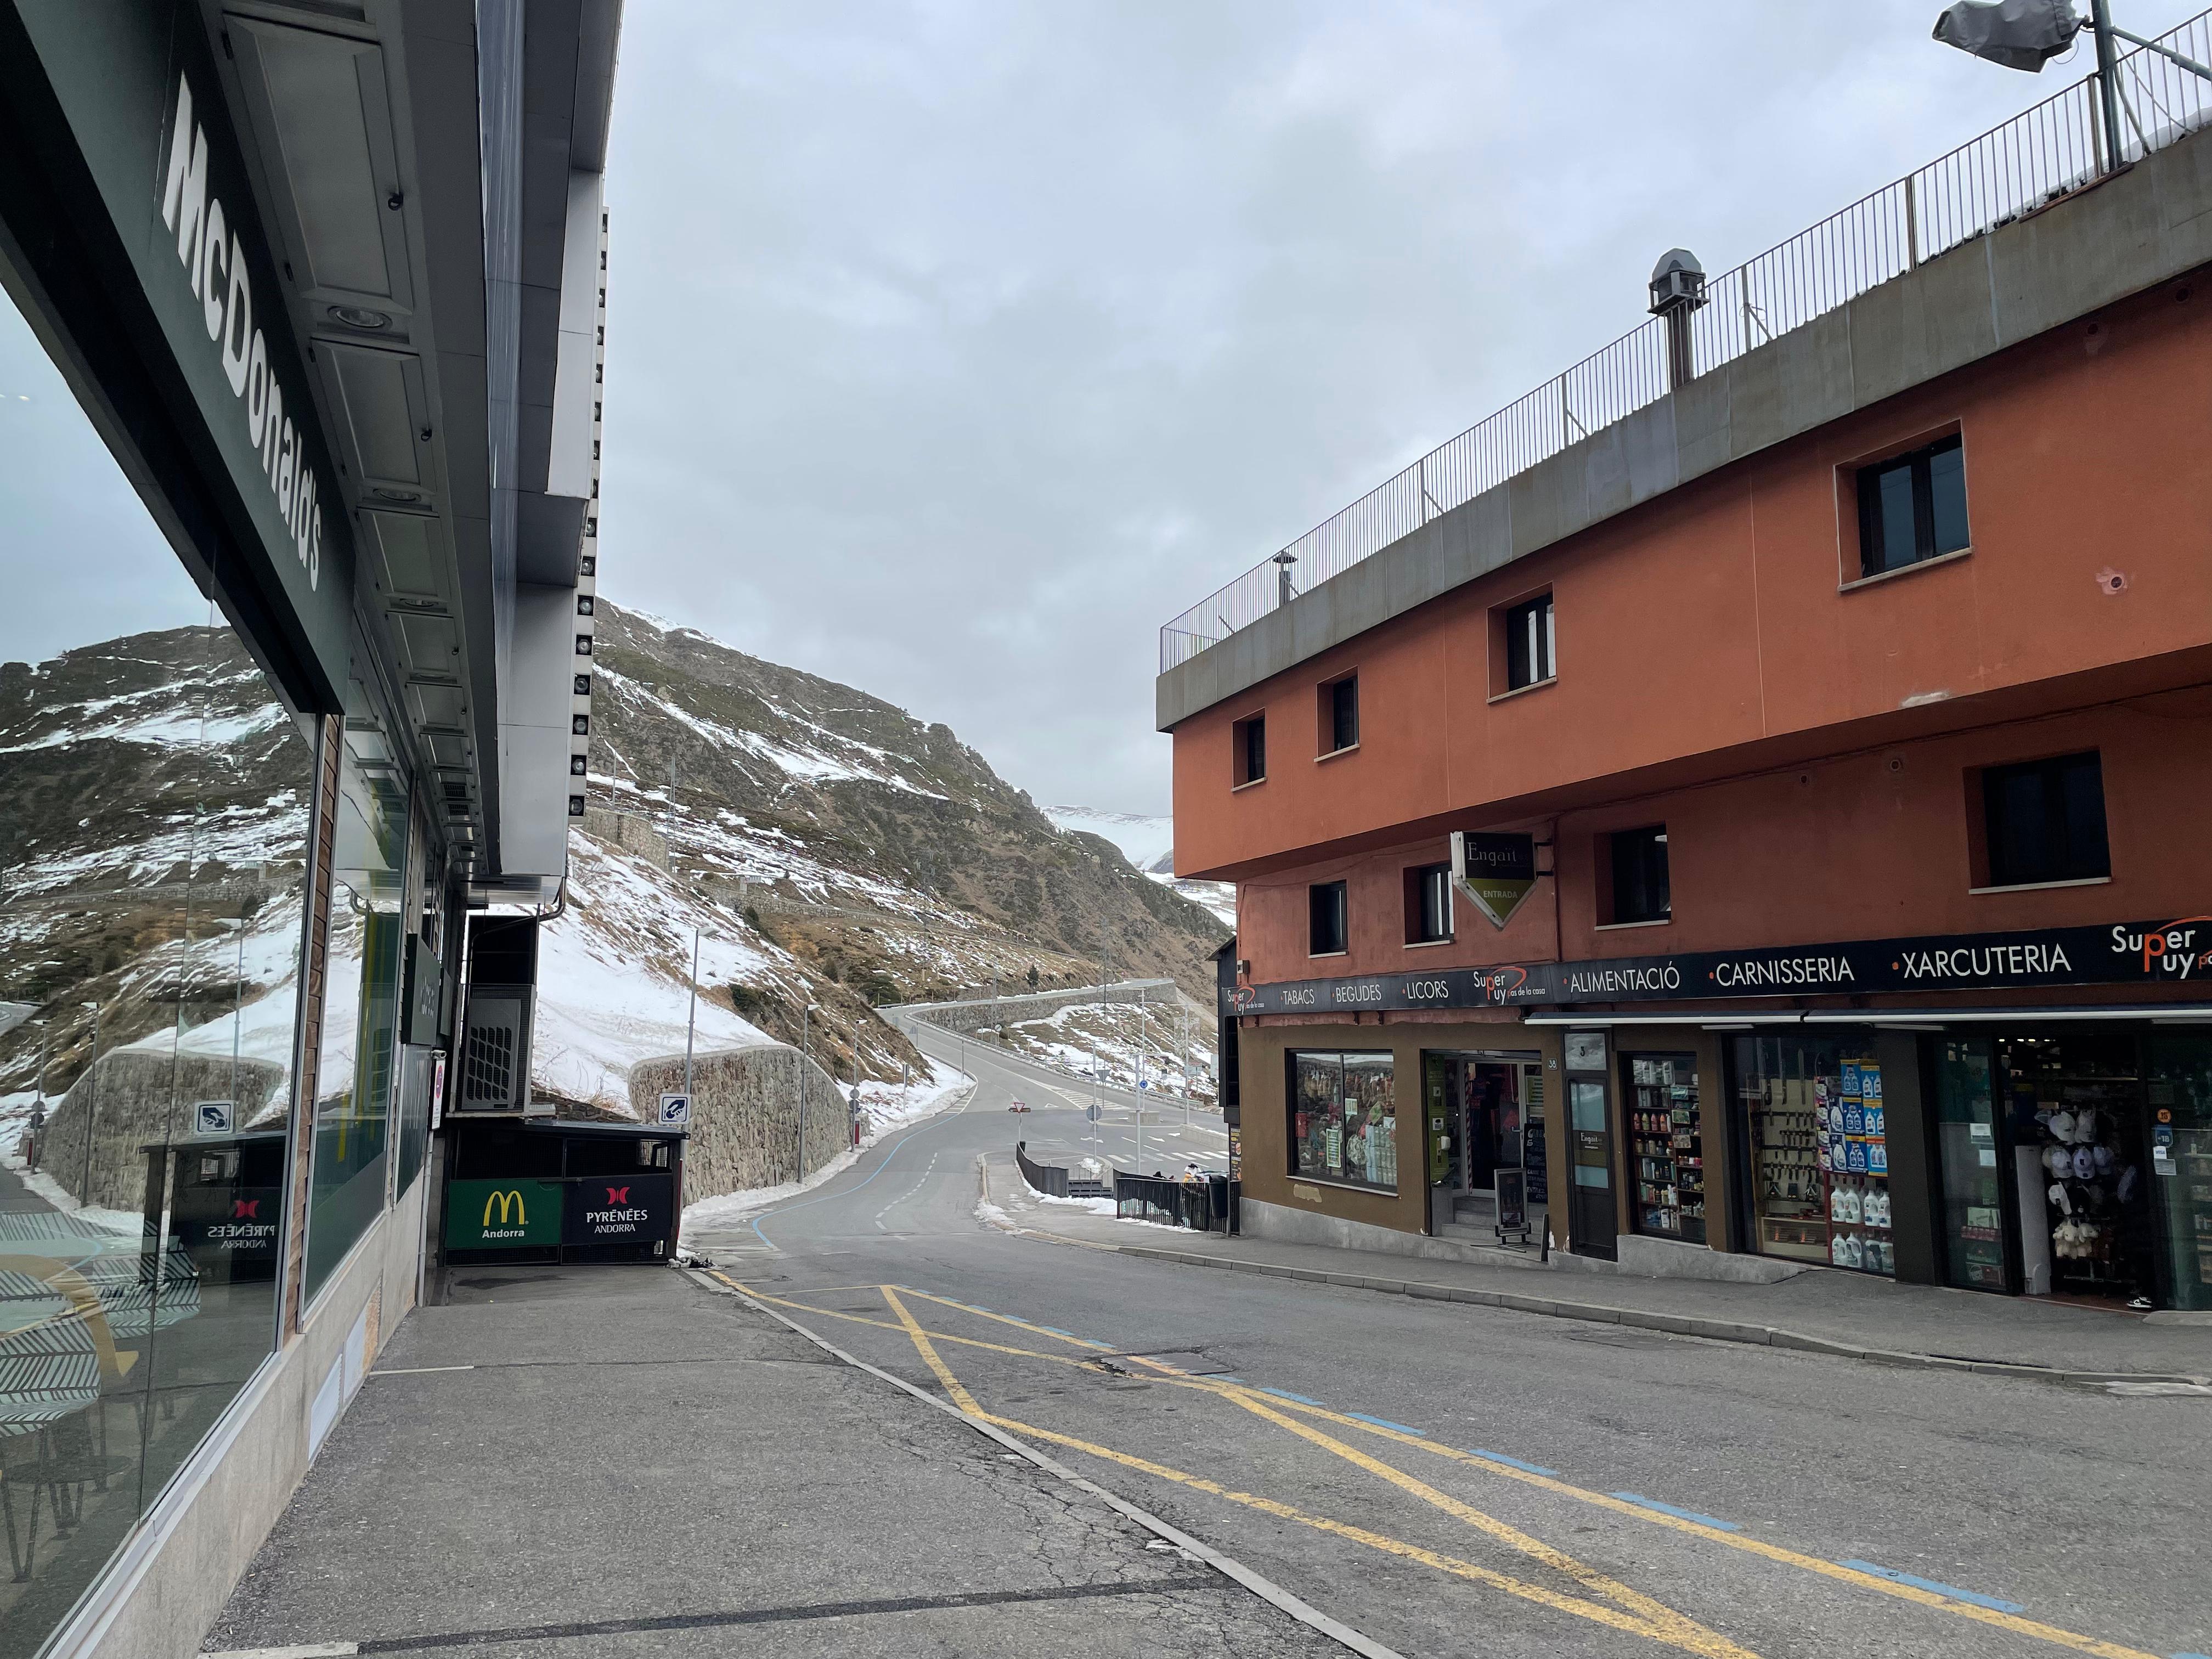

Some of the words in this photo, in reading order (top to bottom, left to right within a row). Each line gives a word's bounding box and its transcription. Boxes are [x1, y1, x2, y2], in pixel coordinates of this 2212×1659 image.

[162, 70, 322, 591] McDonald's
[2111, 926, 2196, 972] Super
[1717, 956, 1855, 986] CARNISSERIA
[1902, 943, 2072, 978] XARCUTERIA
[1474, 971, 1505, 1000] Super
[1570, 961, 1680, 993] ALIMENTACIÓ
[1228, 989, 1244, 1011] Super
[1283, 989, 1315, 1005] TABACS
[1336, 984, 1382, 1003] BEGUDES
[1407, 980, 1449, 999] LICORS
[1518, 986, 1525, 996] de
[1526, 986, 1531, 995] la
[482, 1229, 524, 1238] Andorra
[594, 1223, 635, 1234] ANDORRA
